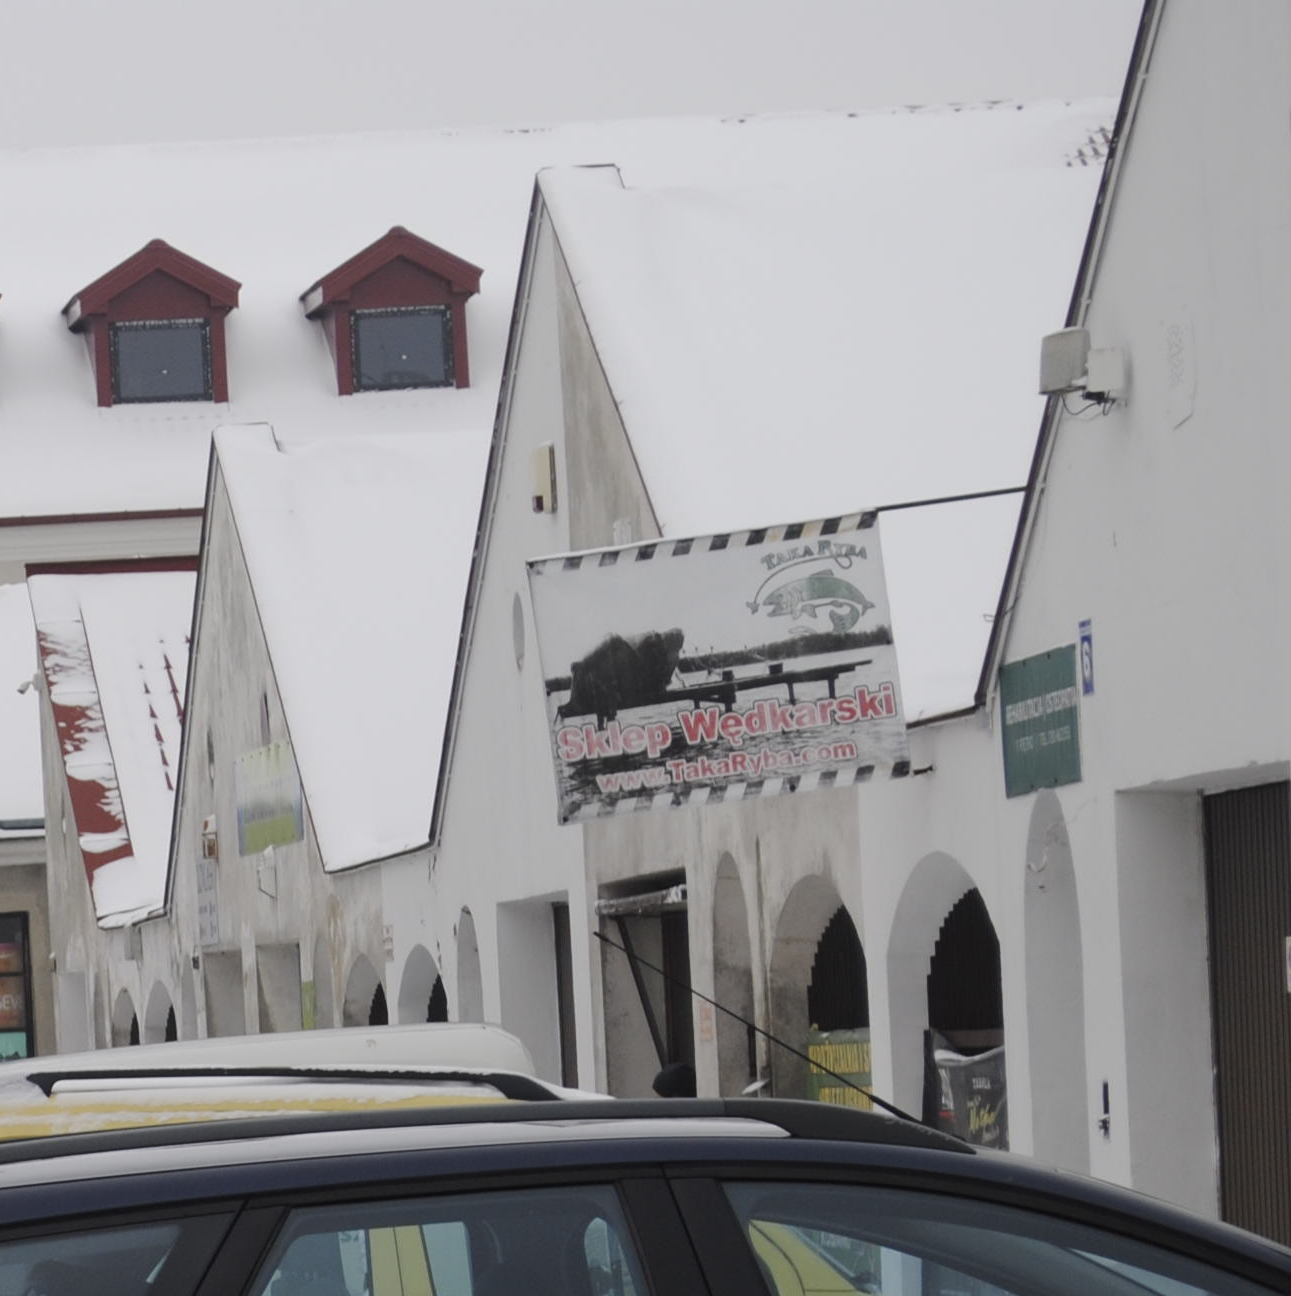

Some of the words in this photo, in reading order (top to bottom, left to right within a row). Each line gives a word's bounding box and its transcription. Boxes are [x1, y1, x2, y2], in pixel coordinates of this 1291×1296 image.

[557, 720, 672, 762] Sklep
[679, 683, 897, 748] Wędkarski
[596, 741, 857, 795] www.TakaRyba.com
